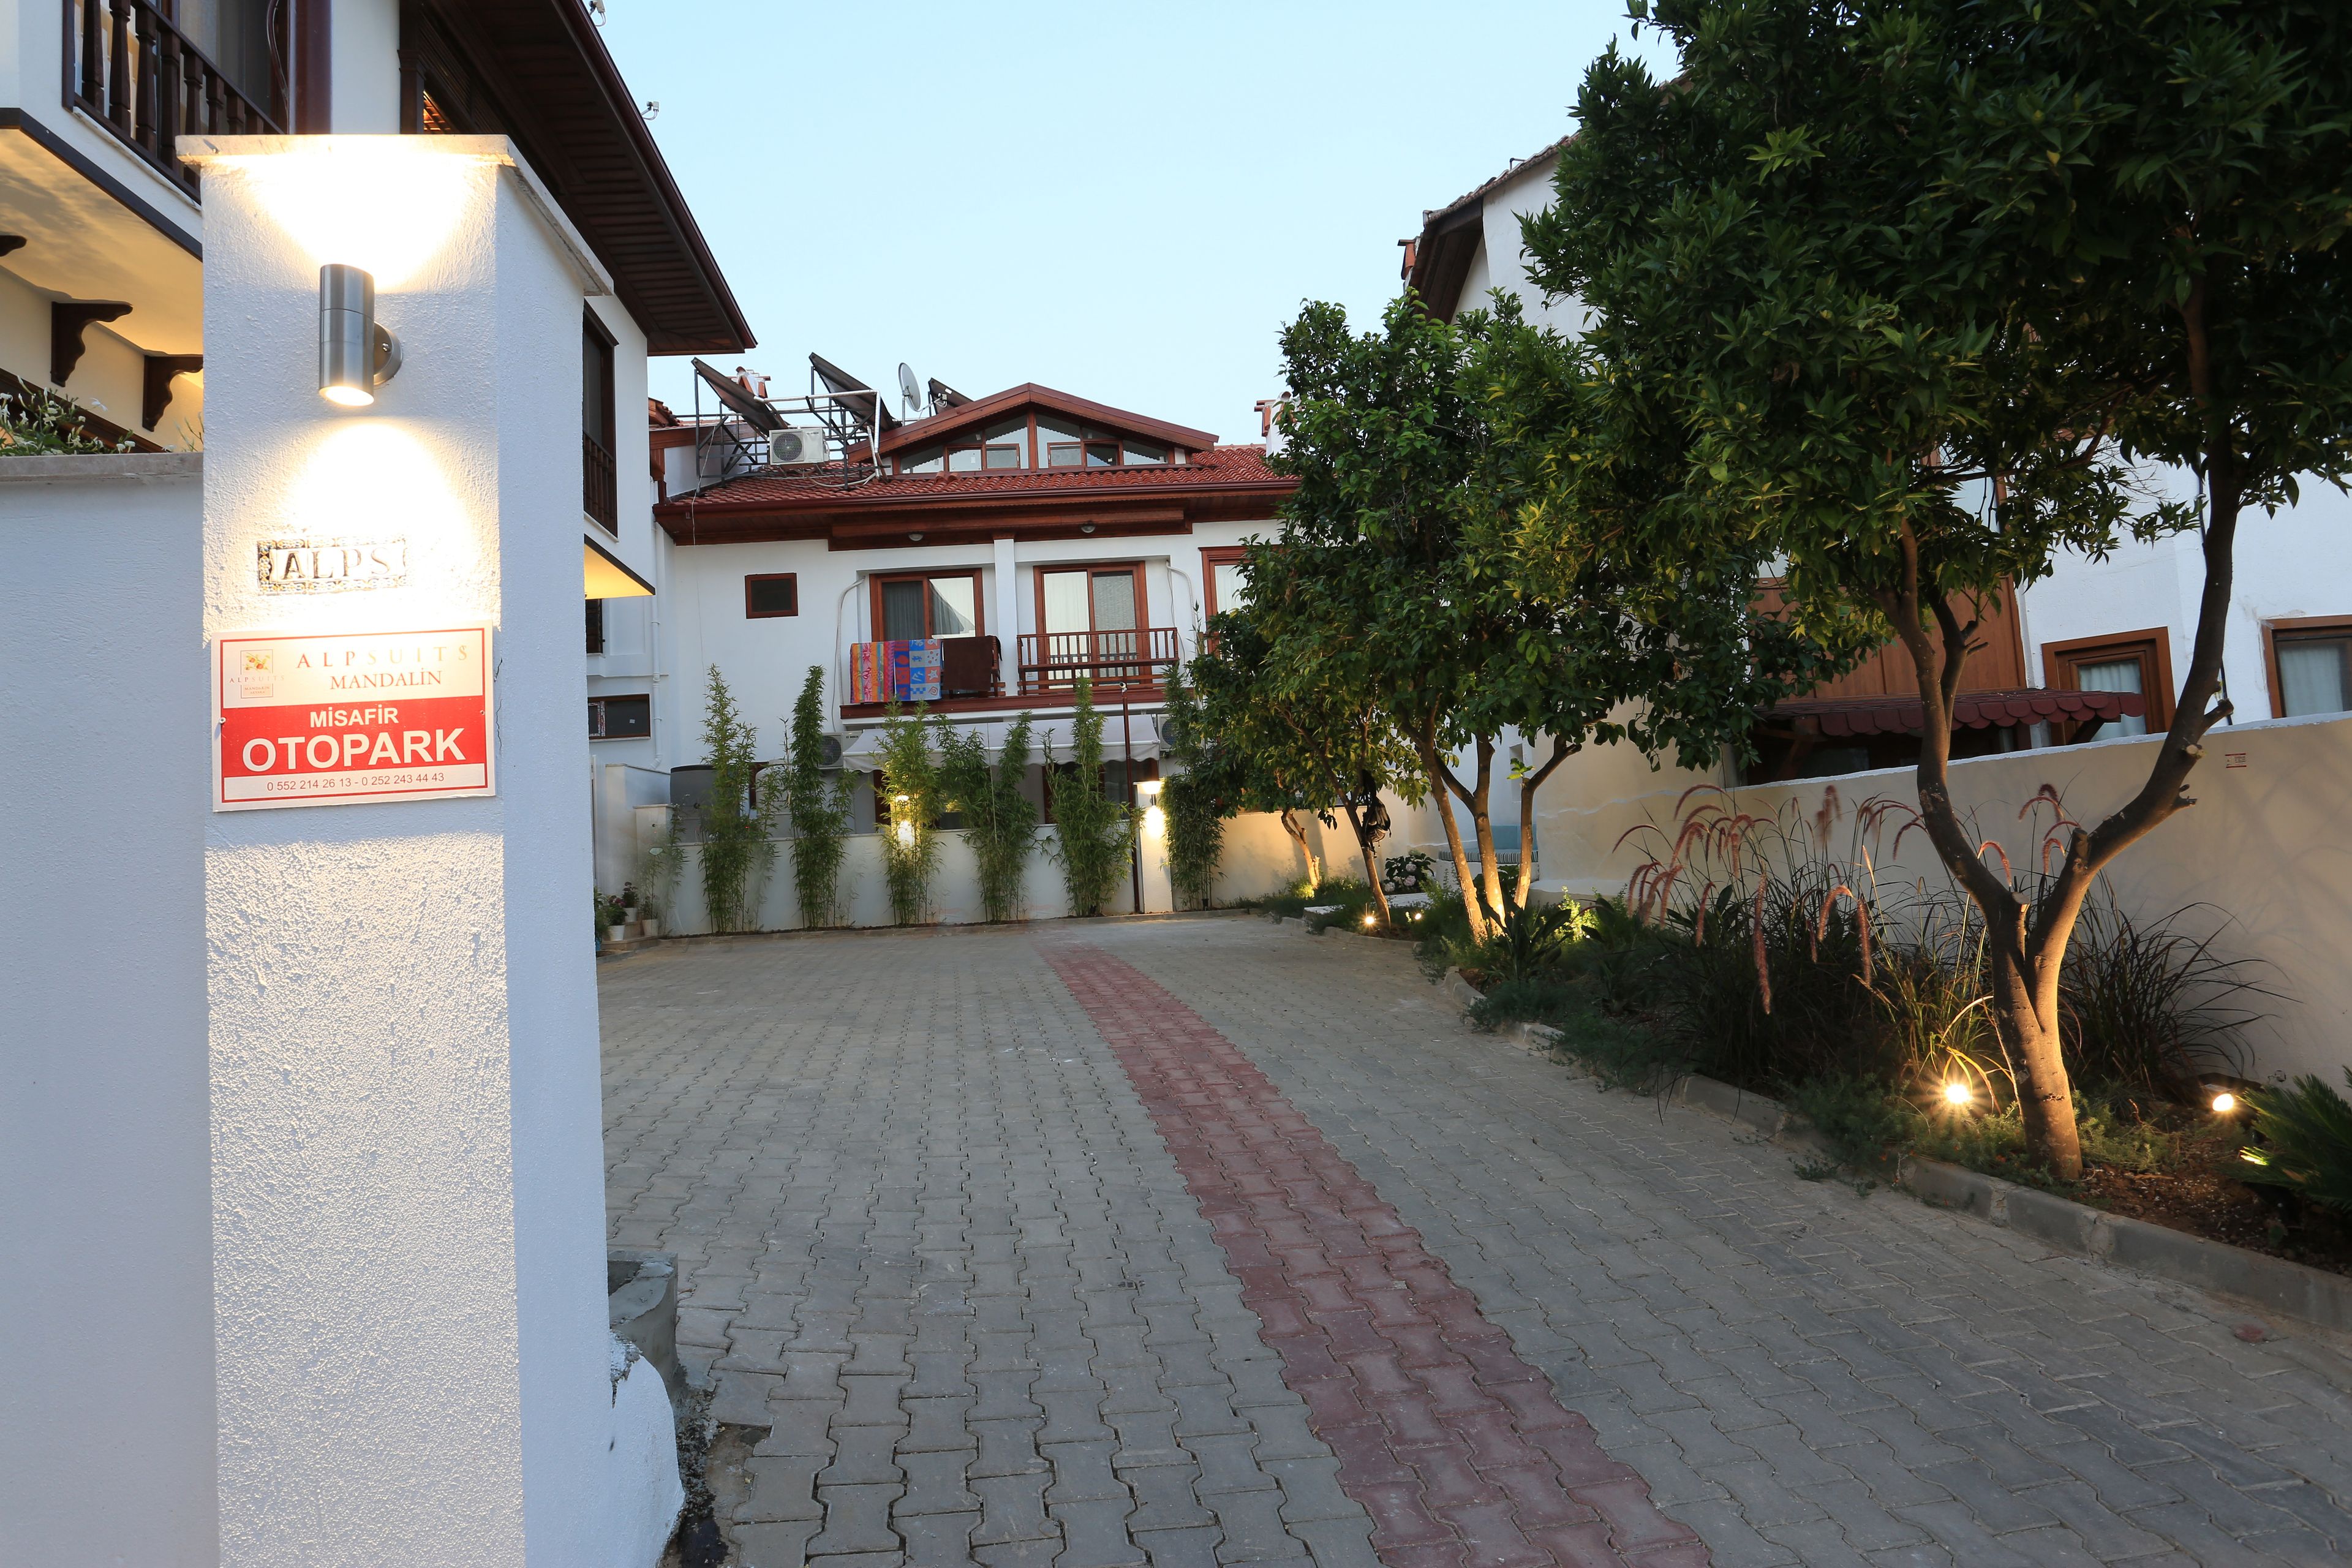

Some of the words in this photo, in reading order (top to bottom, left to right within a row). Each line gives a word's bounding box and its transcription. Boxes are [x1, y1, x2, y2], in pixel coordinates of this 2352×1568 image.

[282, 547, 390, 579] ALPS
[296, 645, 467, 668] ALPSUITS
[330, 667, 442, 690] MANDALİN
[310, 704, 399, 728] MİSAFİR
[242, 728, 466, 772] OTOPARK
[267, 782, 274, 791] 0
[277, 780, 296, 791] 552
[300, 779, 319, 790] 214
[322, 778, 335, 788] 26
[339, 777, 352, 787] 13
[361, 776, 368, 786] 0
[371, 774, 390, 785] 252
[393, 774, 413, 784] 243
[415, 773, 428, 783] 44
[432, 772, 445, 782] 43
